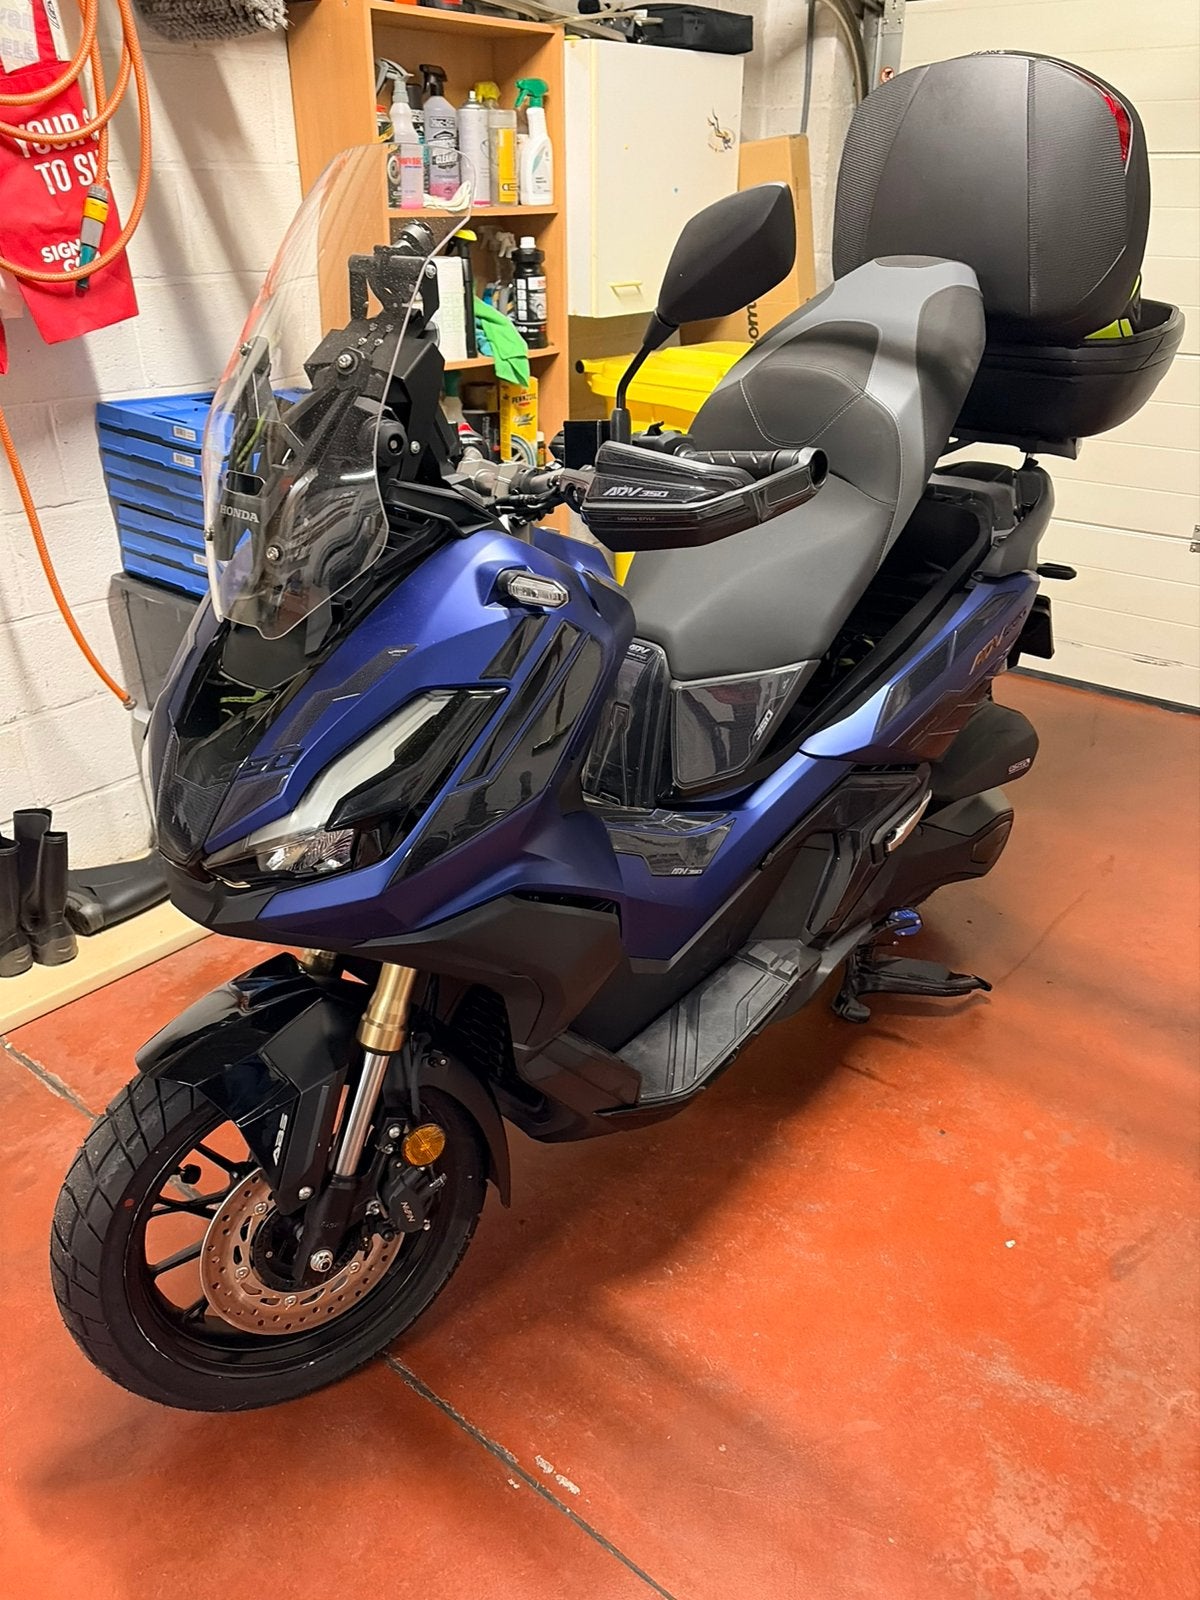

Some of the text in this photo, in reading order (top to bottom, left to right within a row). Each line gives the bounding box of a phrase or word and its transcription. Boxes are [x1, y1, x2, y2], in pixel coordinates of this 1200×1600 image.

[13, 112, 85, 159] YOUR
[34, 159, 72, 196] TO
[602, 486, 669, 498] ADV 350
[219, 504, 260, 524] HONDA
[753, 708, 774, 741] 350
